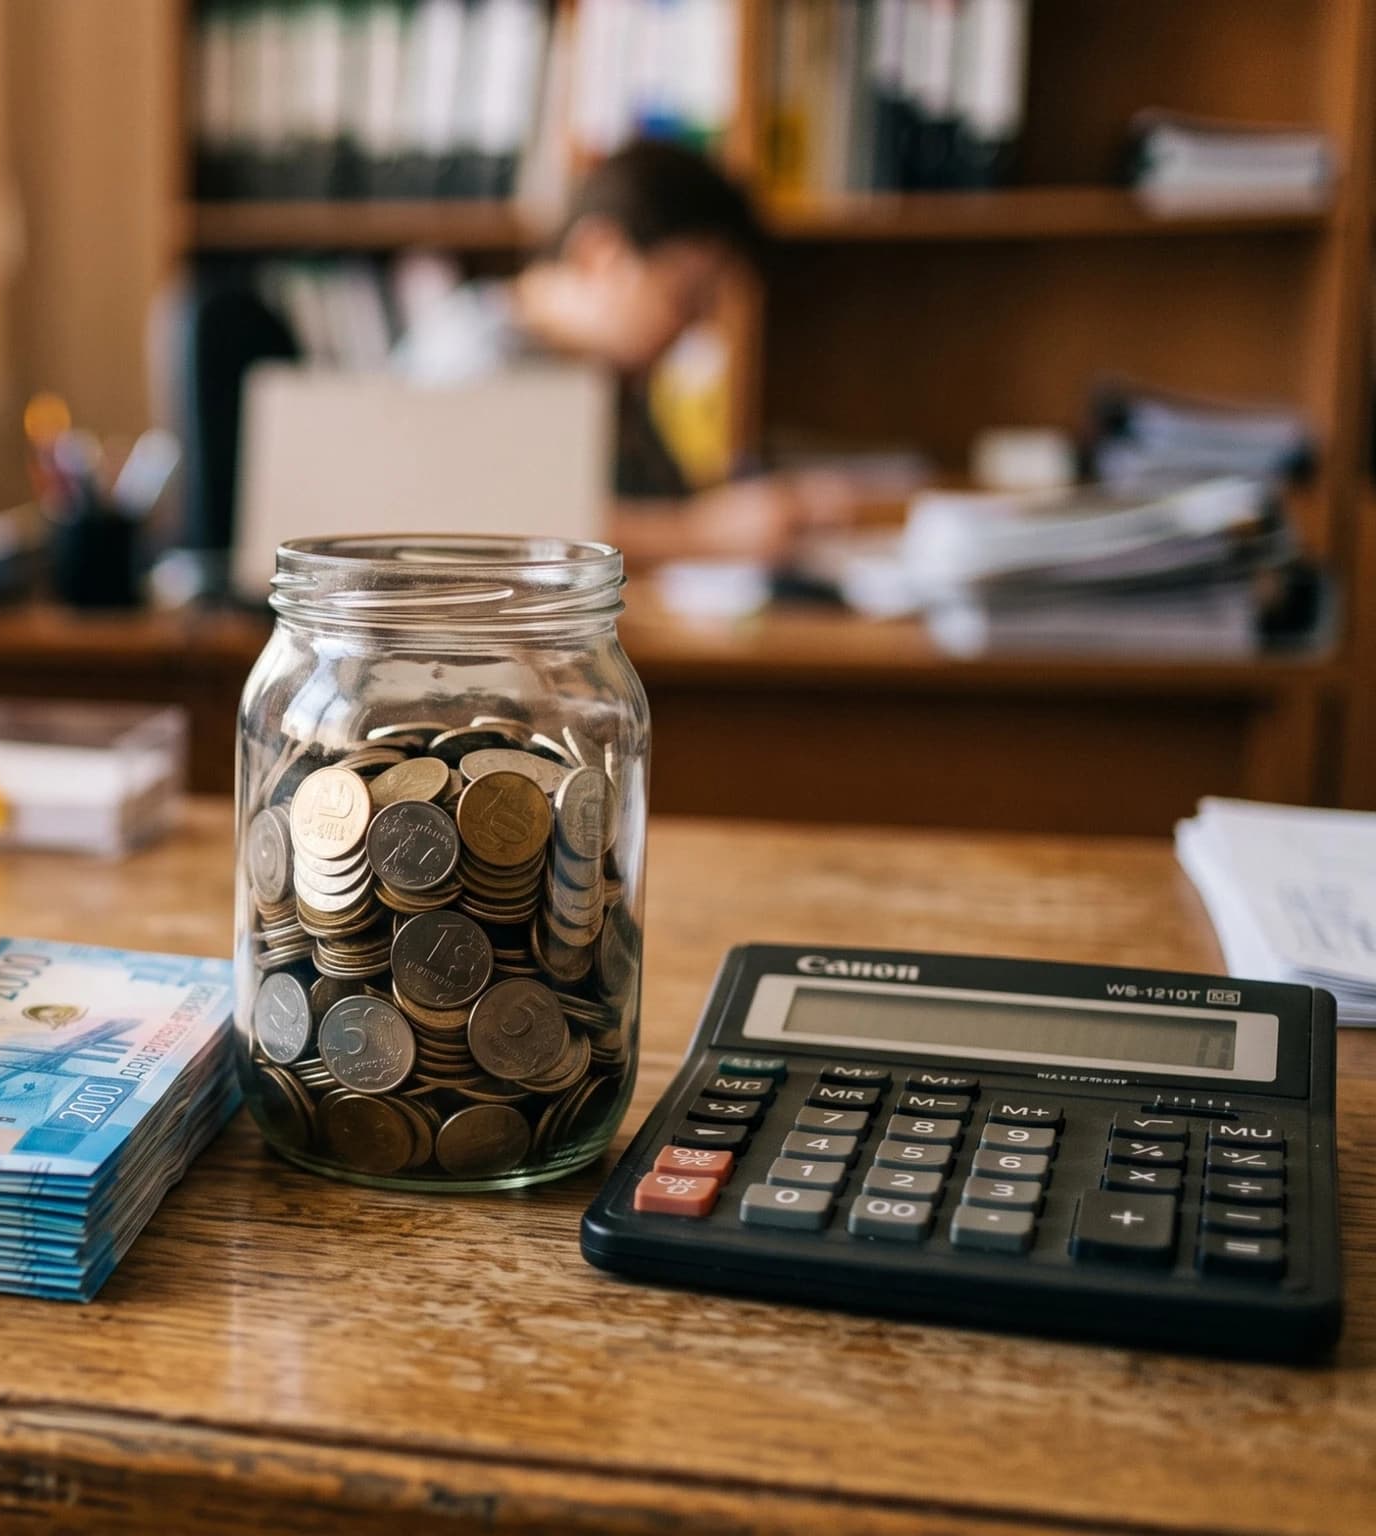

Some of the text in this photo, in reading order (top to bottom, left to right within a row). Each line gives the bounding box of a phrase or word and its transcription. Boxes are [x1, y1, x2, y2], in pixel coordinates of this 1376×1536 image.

[796, 954, 920, 982] Canon
[1106, 983, 1201, 1001] WS-1210T
[819, 1087, 865, 1100] MR
[59, 1084, 123, 1125] 2000
[1002, 1105, 1050, 1117] M+
[823, 1112, 844, 1124] 7
[911, 1121, 936, 1134] 8
[1220, 1124, 1273, 1138] MU
[1007, 1130, 1030, 1142] 9
[806, 1138, 830, 1151] 4
[901, 1147, 926, 1159] 5
[999, 1156, 1022, 1169] 6
[801, 1164, 814, 1177] 1
[890, 1174, 915, 1188] 2
[990, 1183, 1015, 1197] 3
[775, 1190, 800, 1204] 0
[866, 1201, 917, 1217] 00
